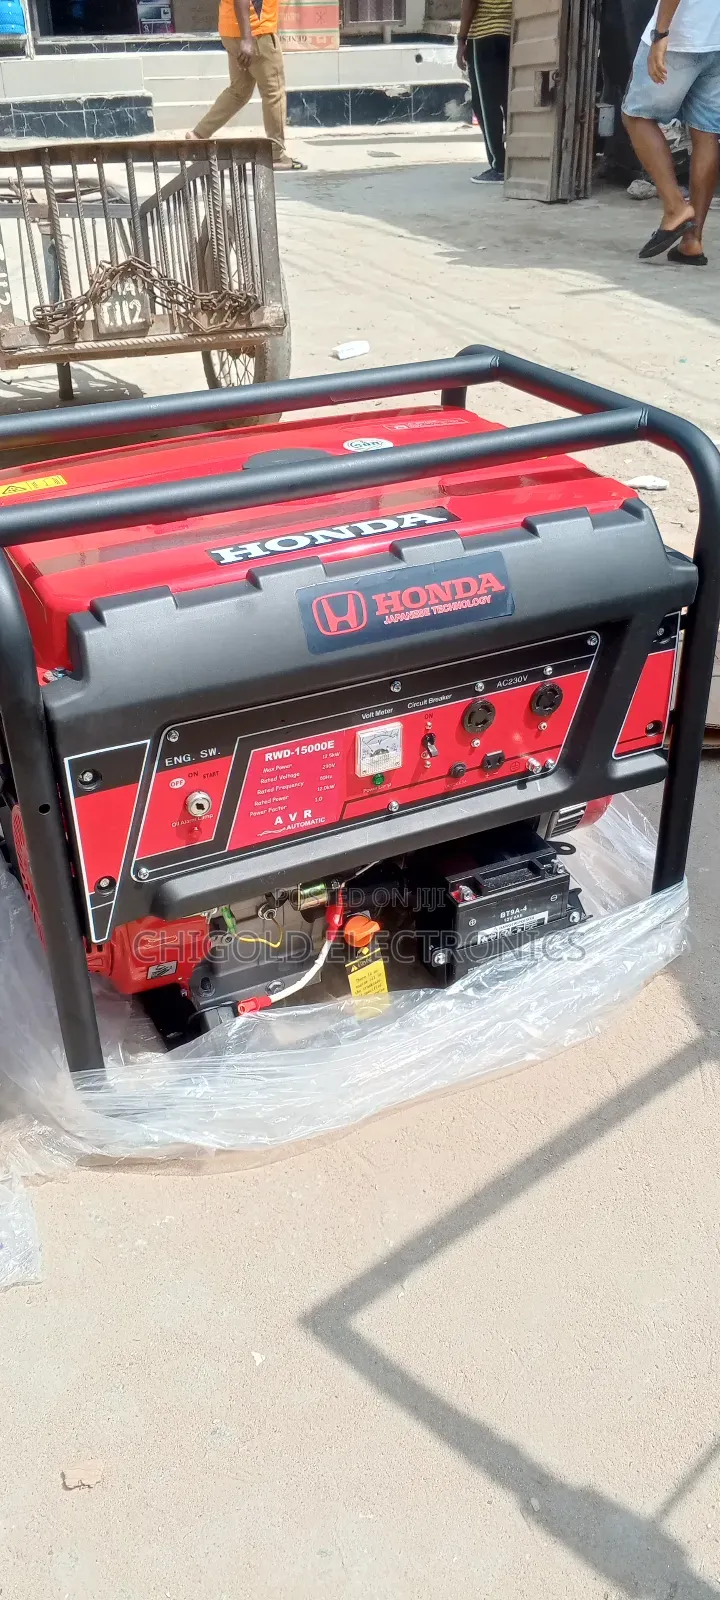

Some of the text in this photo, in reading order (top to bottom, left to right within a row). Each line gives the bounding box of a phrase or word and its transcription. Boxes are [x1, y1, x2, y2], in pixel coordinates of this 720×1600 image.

[211, 512, 447, 564] HONDA
[372, 572, 505, 616] HONDA
[432, 595, 491, 616] TECHNOLOGY
[496, 675, 529, 688] AC230V
[407, 694, 453, 709] Circuit Breaker
[361, 707, 394, 720] Volt Meter
[165, 747, 221, 767] ENG. SW.
[264, 740, 335, 762] RWD-15000E
[203, 771, 219, 779] START
[260, 775, 278, 784] Rated
[170, 779, 184, 787] OFF
[257, 786, 275, 795] Rated
[254, 795, 289, 806] Rated Power
[249, 809, 267, 817] Power
[274, 809, 312, 825] A V R
[285, 817, 326, 830] AUTOMATIC
